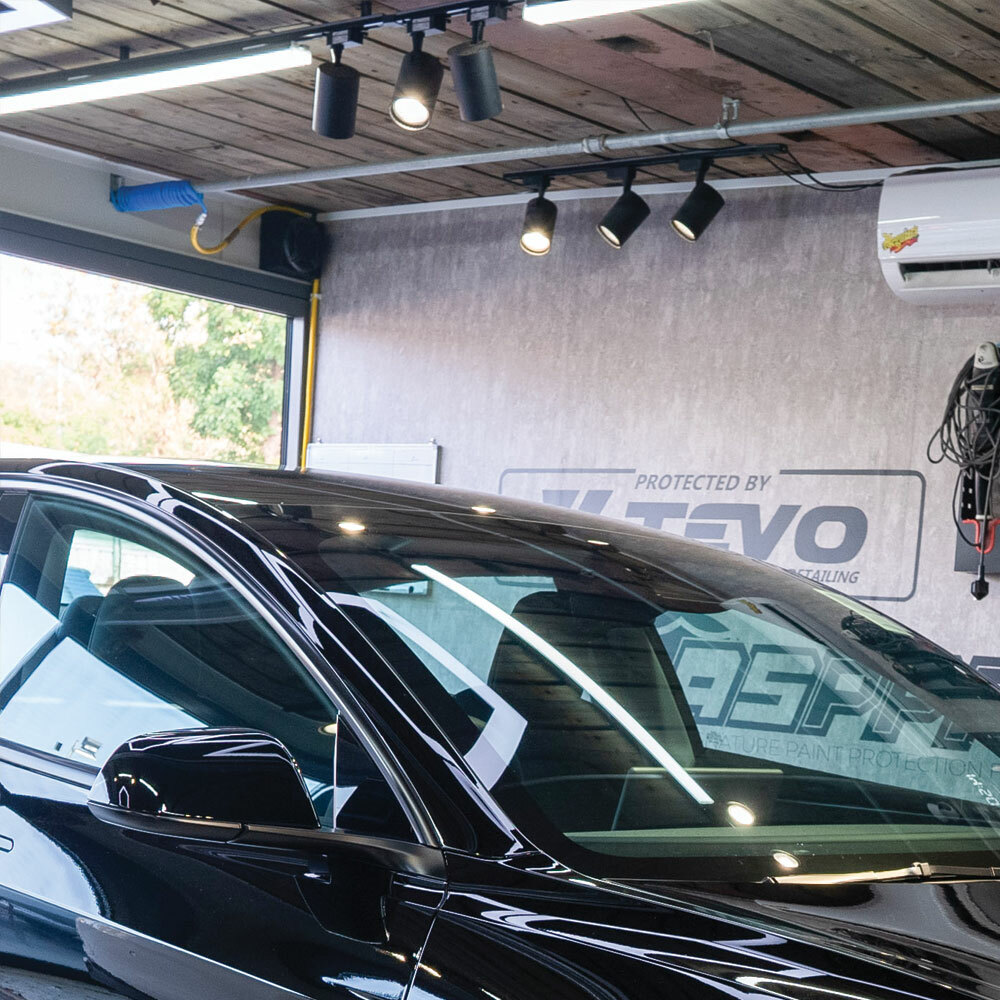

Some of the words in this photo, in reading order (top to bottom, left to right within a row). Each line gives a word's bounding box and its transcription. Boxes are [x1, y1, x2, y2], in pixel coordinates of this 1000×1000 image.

[635, 474, 740, 491] PROTECTED
[744, 475, 772, 491] BY
[625, 501, 868, 564] TEVO
[787, 740, 843, 762] PAINT
[849, 749, 983, 778] PROTECTION
